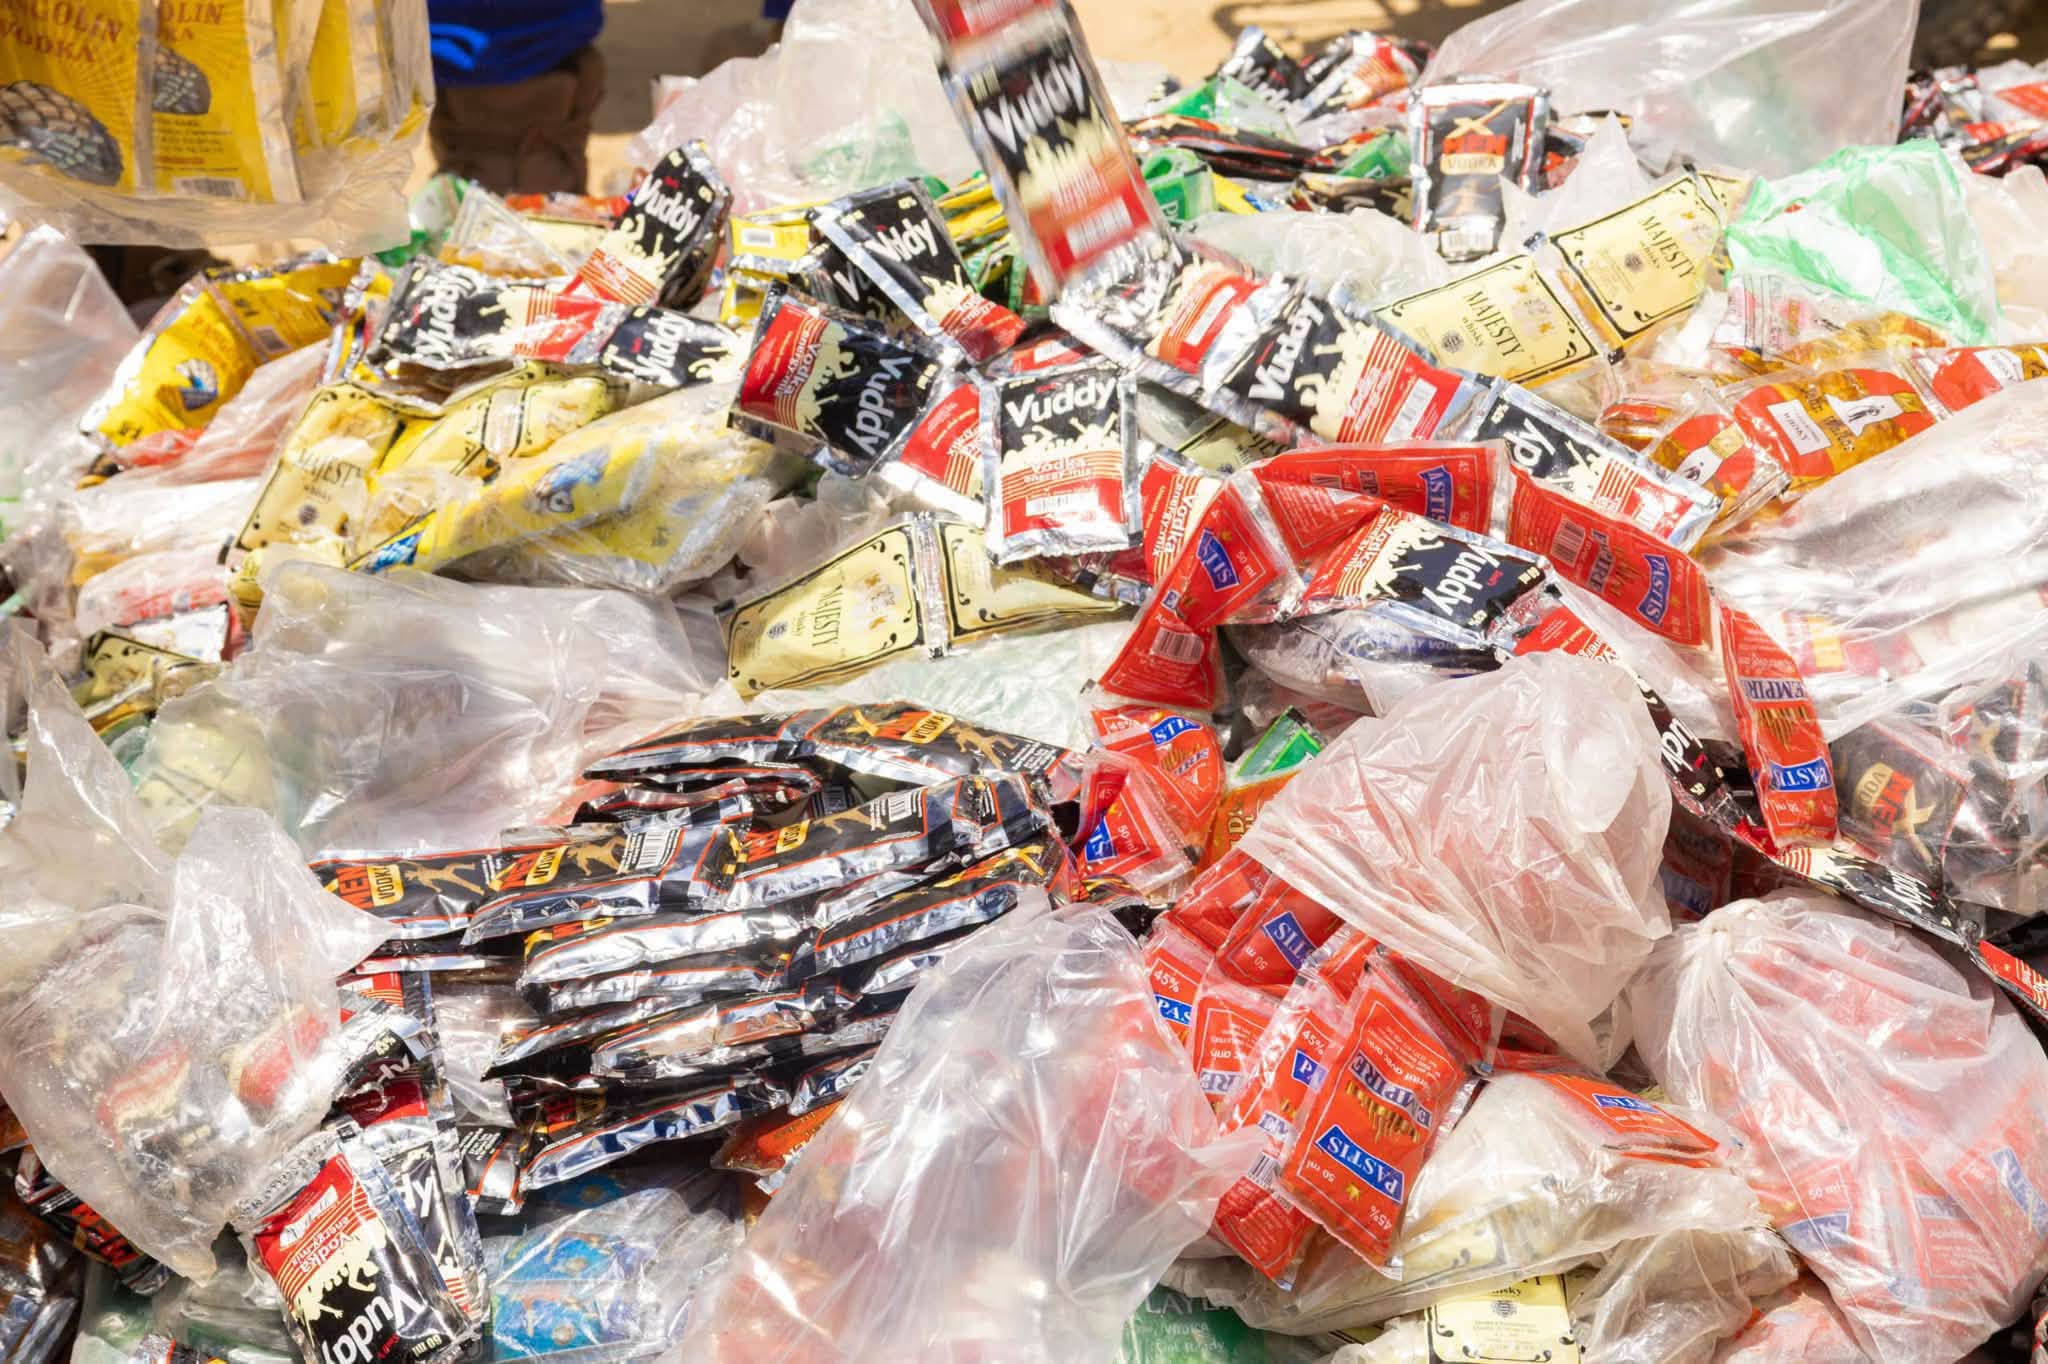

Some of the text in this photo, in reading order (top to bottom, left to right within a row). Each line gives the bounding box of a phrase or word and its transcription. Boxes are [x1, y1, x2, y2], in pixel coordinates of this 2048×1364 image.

[636, 179, 700, 243] Vuddy
[864, 219, 939, 264] Vdy
[1640, 216, 1697, 278] MAJESTY
[636, 313, 695, 386] Vuddy
[1248, 298, 1326, 401] Vuddy
[1463, 291, 1524, 357] MAJESTY
[783, 343, 822, 395] Vodka
[845, 356, 913, 456] Vuddy
[1006, 376, 1117, 429] Vuddy
[1428, 467, 1450, 525] ASTIS
[1163, 493, 1200, 556] Vodka
[1357, 525, 1395, 568] Vodka
[1423, 543, 1500, 615] Vuddy
[1646, 556, 1669, 622] PASTIS
[812, 584, 842, 648] MAJESTY
[911, 713, 946, 742] VODKA
[1857, 773, 1887, 804] VOD
[336, 865, 374, 909] MEN
[1152, 968, 1180, 993] 45%
[1157, 997, 1192, 1024] PAS
[1300, 1028, 1326, 1056] 45%
[1351, 1053, 1431, 1124] EMPIRE
[1322, 1168, 1336, 1183] 50
[1328, 1136, 1398, 1194] PASTIS
[1369, 1204, 1393, 1231] 45%
[301, 1232, 350, 1275] Vodka
[1490, 1285, 1523, 1297] isky
[428, 1334, 443, 1350] 60
